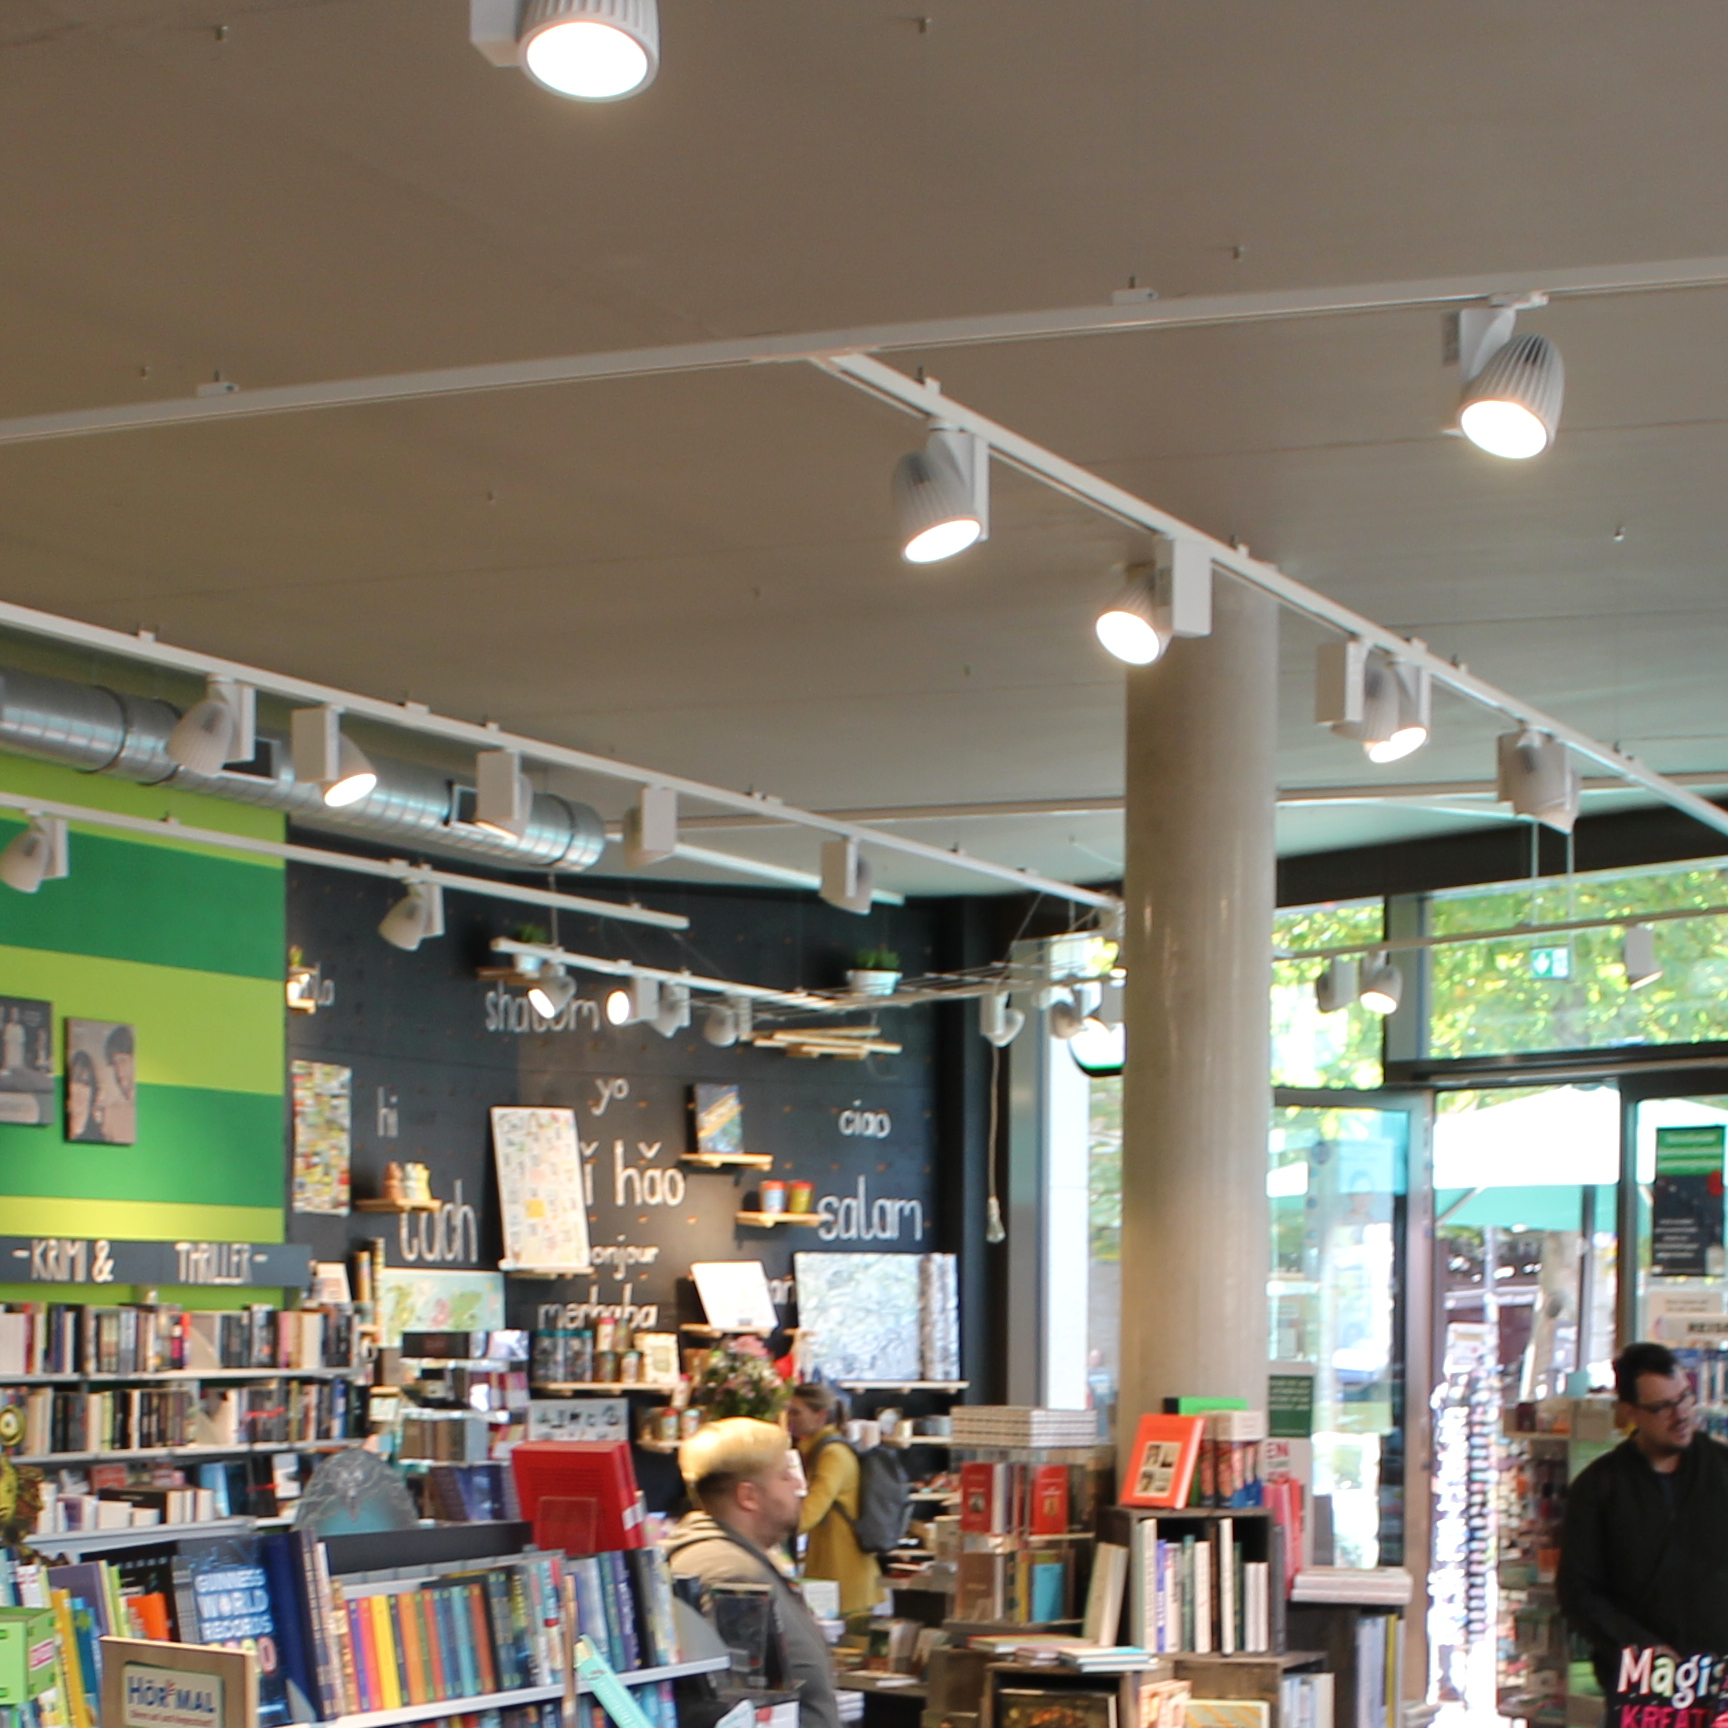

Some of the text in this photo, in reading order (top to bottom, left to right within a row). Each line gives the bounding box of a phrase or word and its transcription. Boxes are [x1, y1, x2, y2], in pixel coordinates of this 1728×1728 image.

[377, 1086, 399, 1139] hi
[591, 1077, 629, 1116] yo
[839, 1099, 891, 1139] ciao
[816, 1175, 924, 1243] salam
[92, 1240, 115, 1284] &
[591, 1234, 660, 1280] onjour
[202, 1614, 273, 1640] RECORDS
[175, 1688, 215, 1714] MAL
